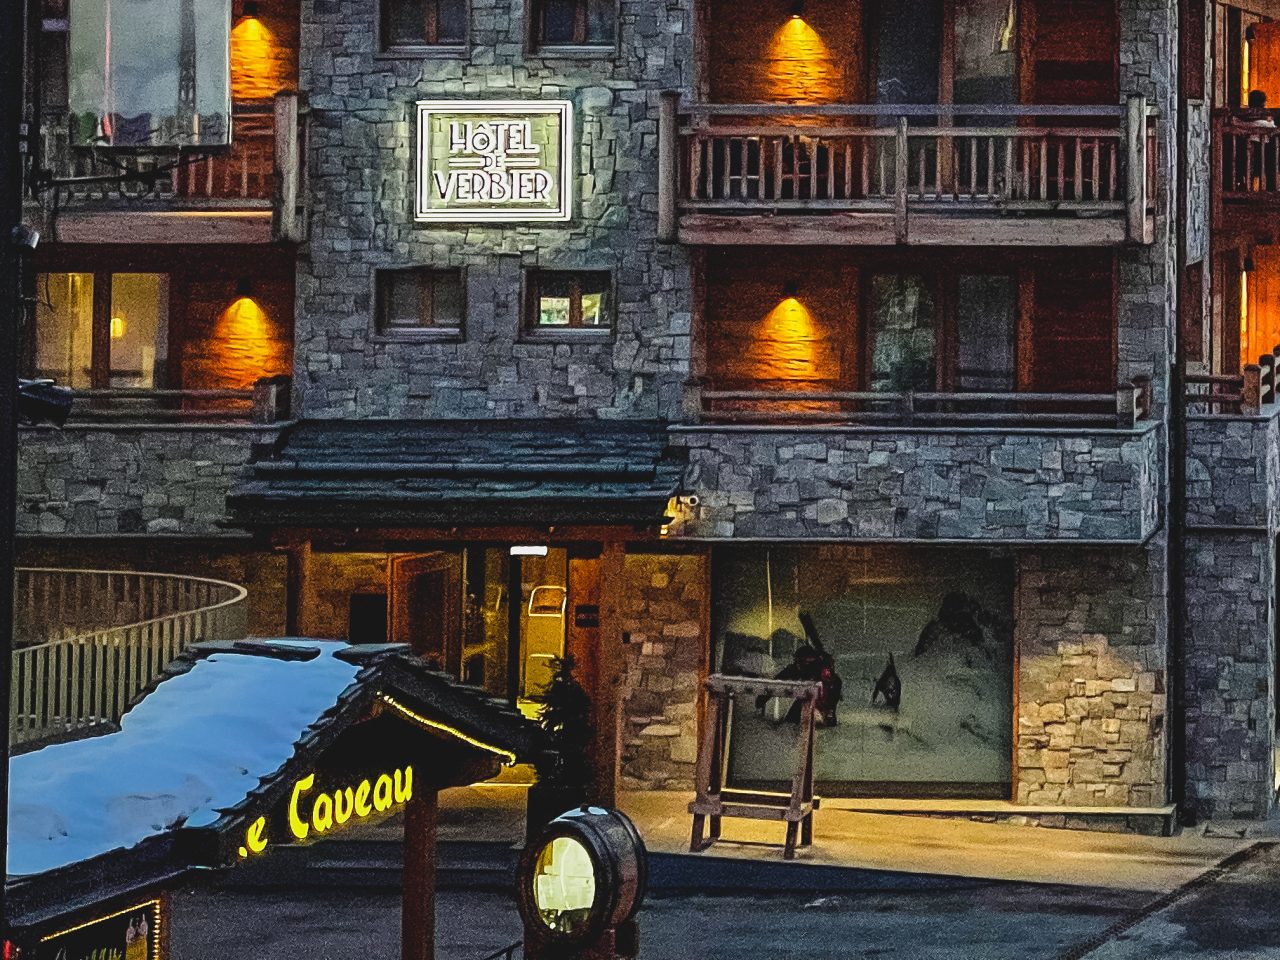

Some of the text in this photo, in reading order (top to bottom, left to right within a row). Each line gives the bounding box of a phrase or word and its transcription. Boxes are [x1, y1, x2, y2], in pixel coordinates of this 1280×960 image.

[448, 120, 540, 154] HÔTEL
[483, 154, 506, 169] DE
[433, 169, 554, 203] VERBIER
[289, 766, 413, 839] Caveau
